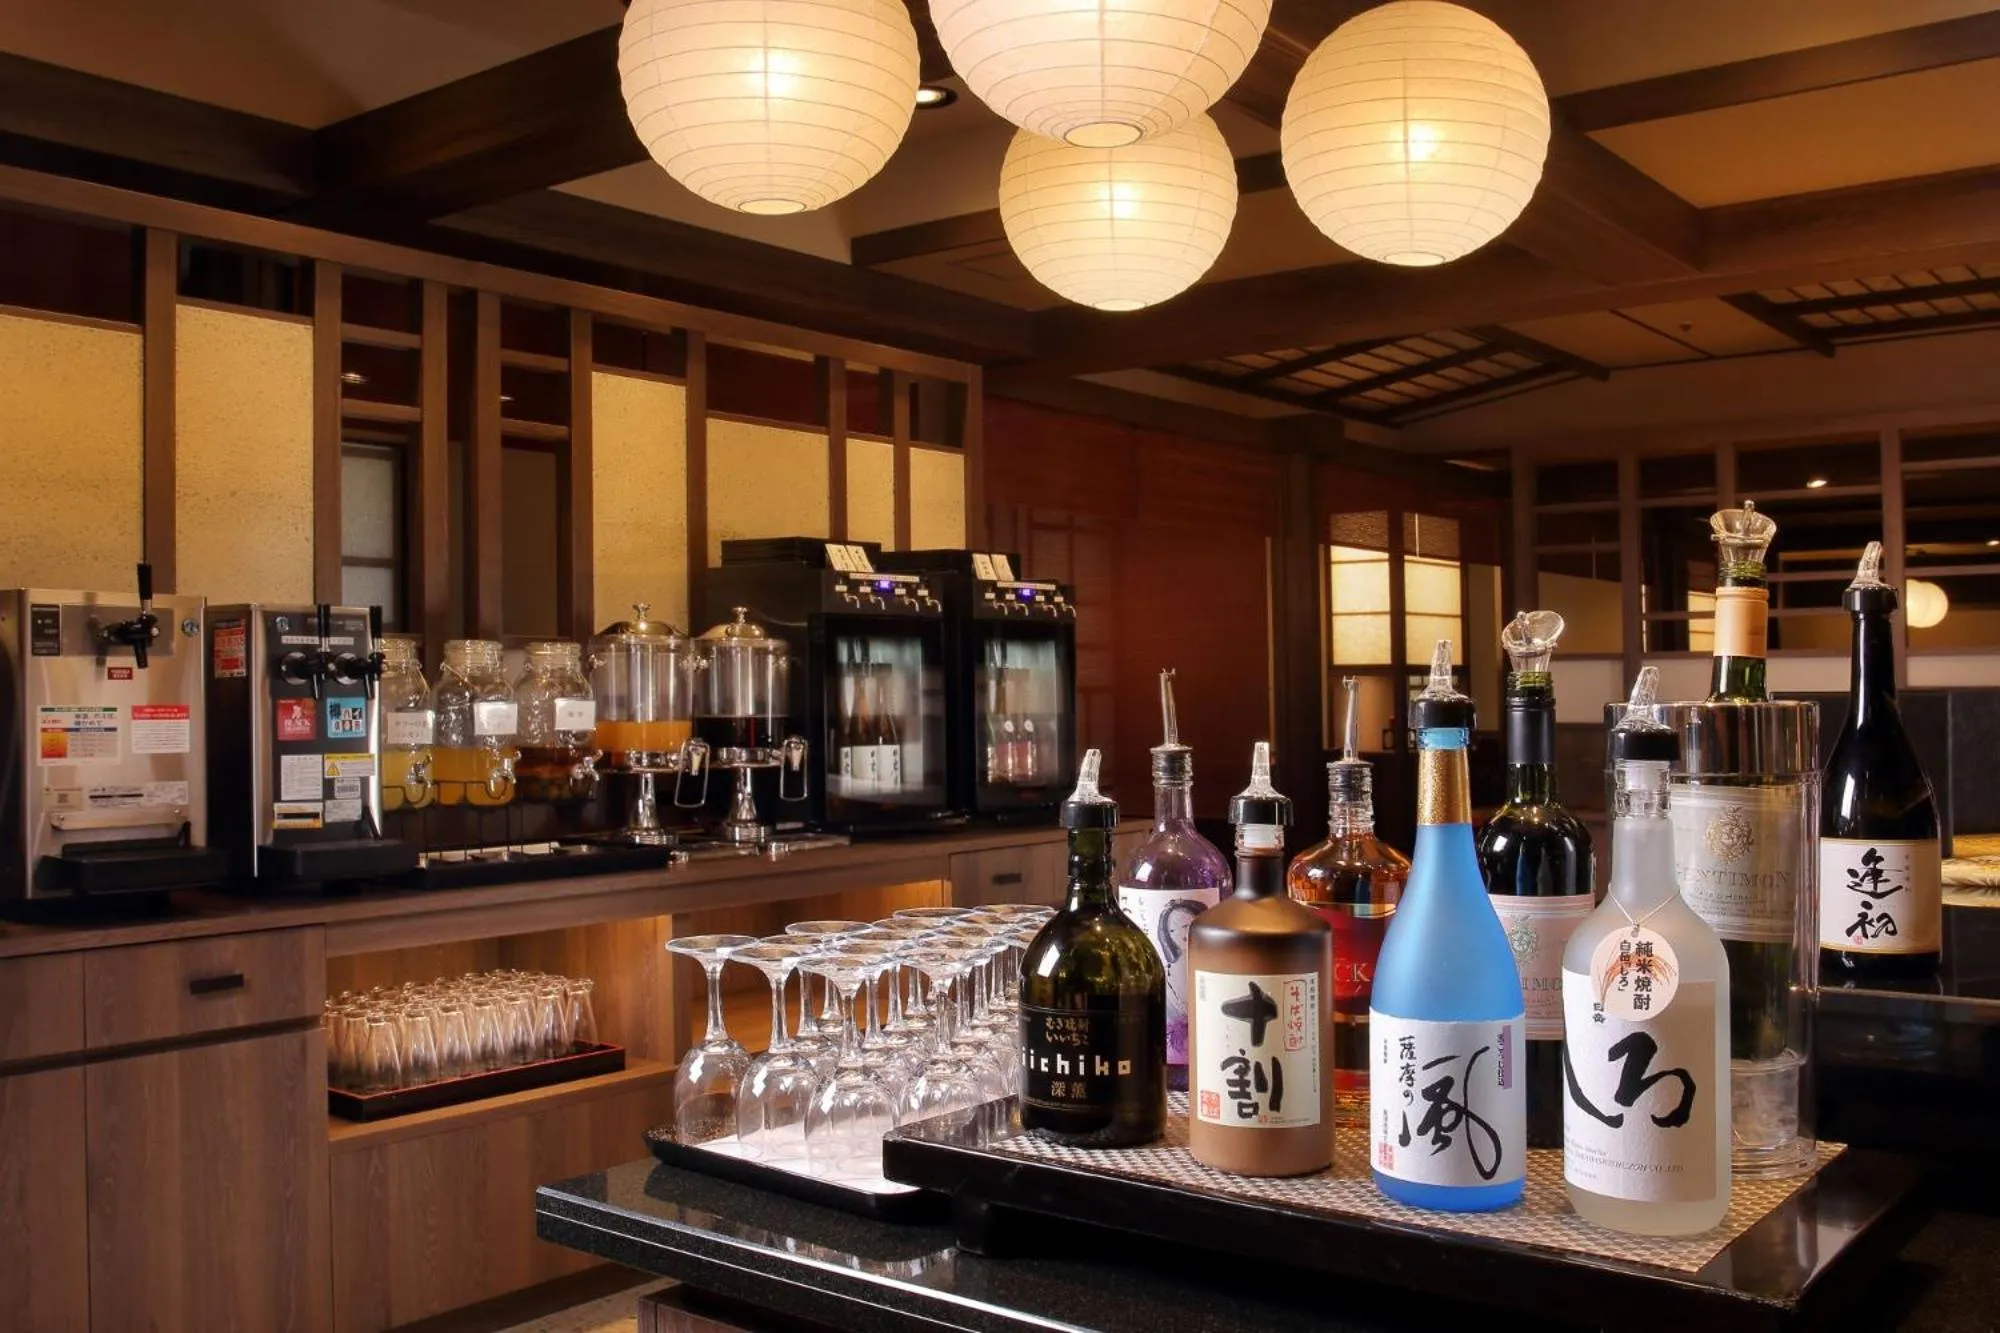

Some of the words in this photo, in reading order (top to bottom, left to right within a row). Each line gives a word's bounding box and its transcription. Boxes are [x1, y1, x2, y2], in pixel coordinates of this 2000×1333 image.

[1632, 941, 1653, 1011] 純米焼酎
[1021, 1046, 1131, 1076] iichiko
[1220, 981, 1283, 1119] 十割
[1398, 1035, 1416, 1107] 薩摩の
[1564, 1031, 1696, 1128] しろ
